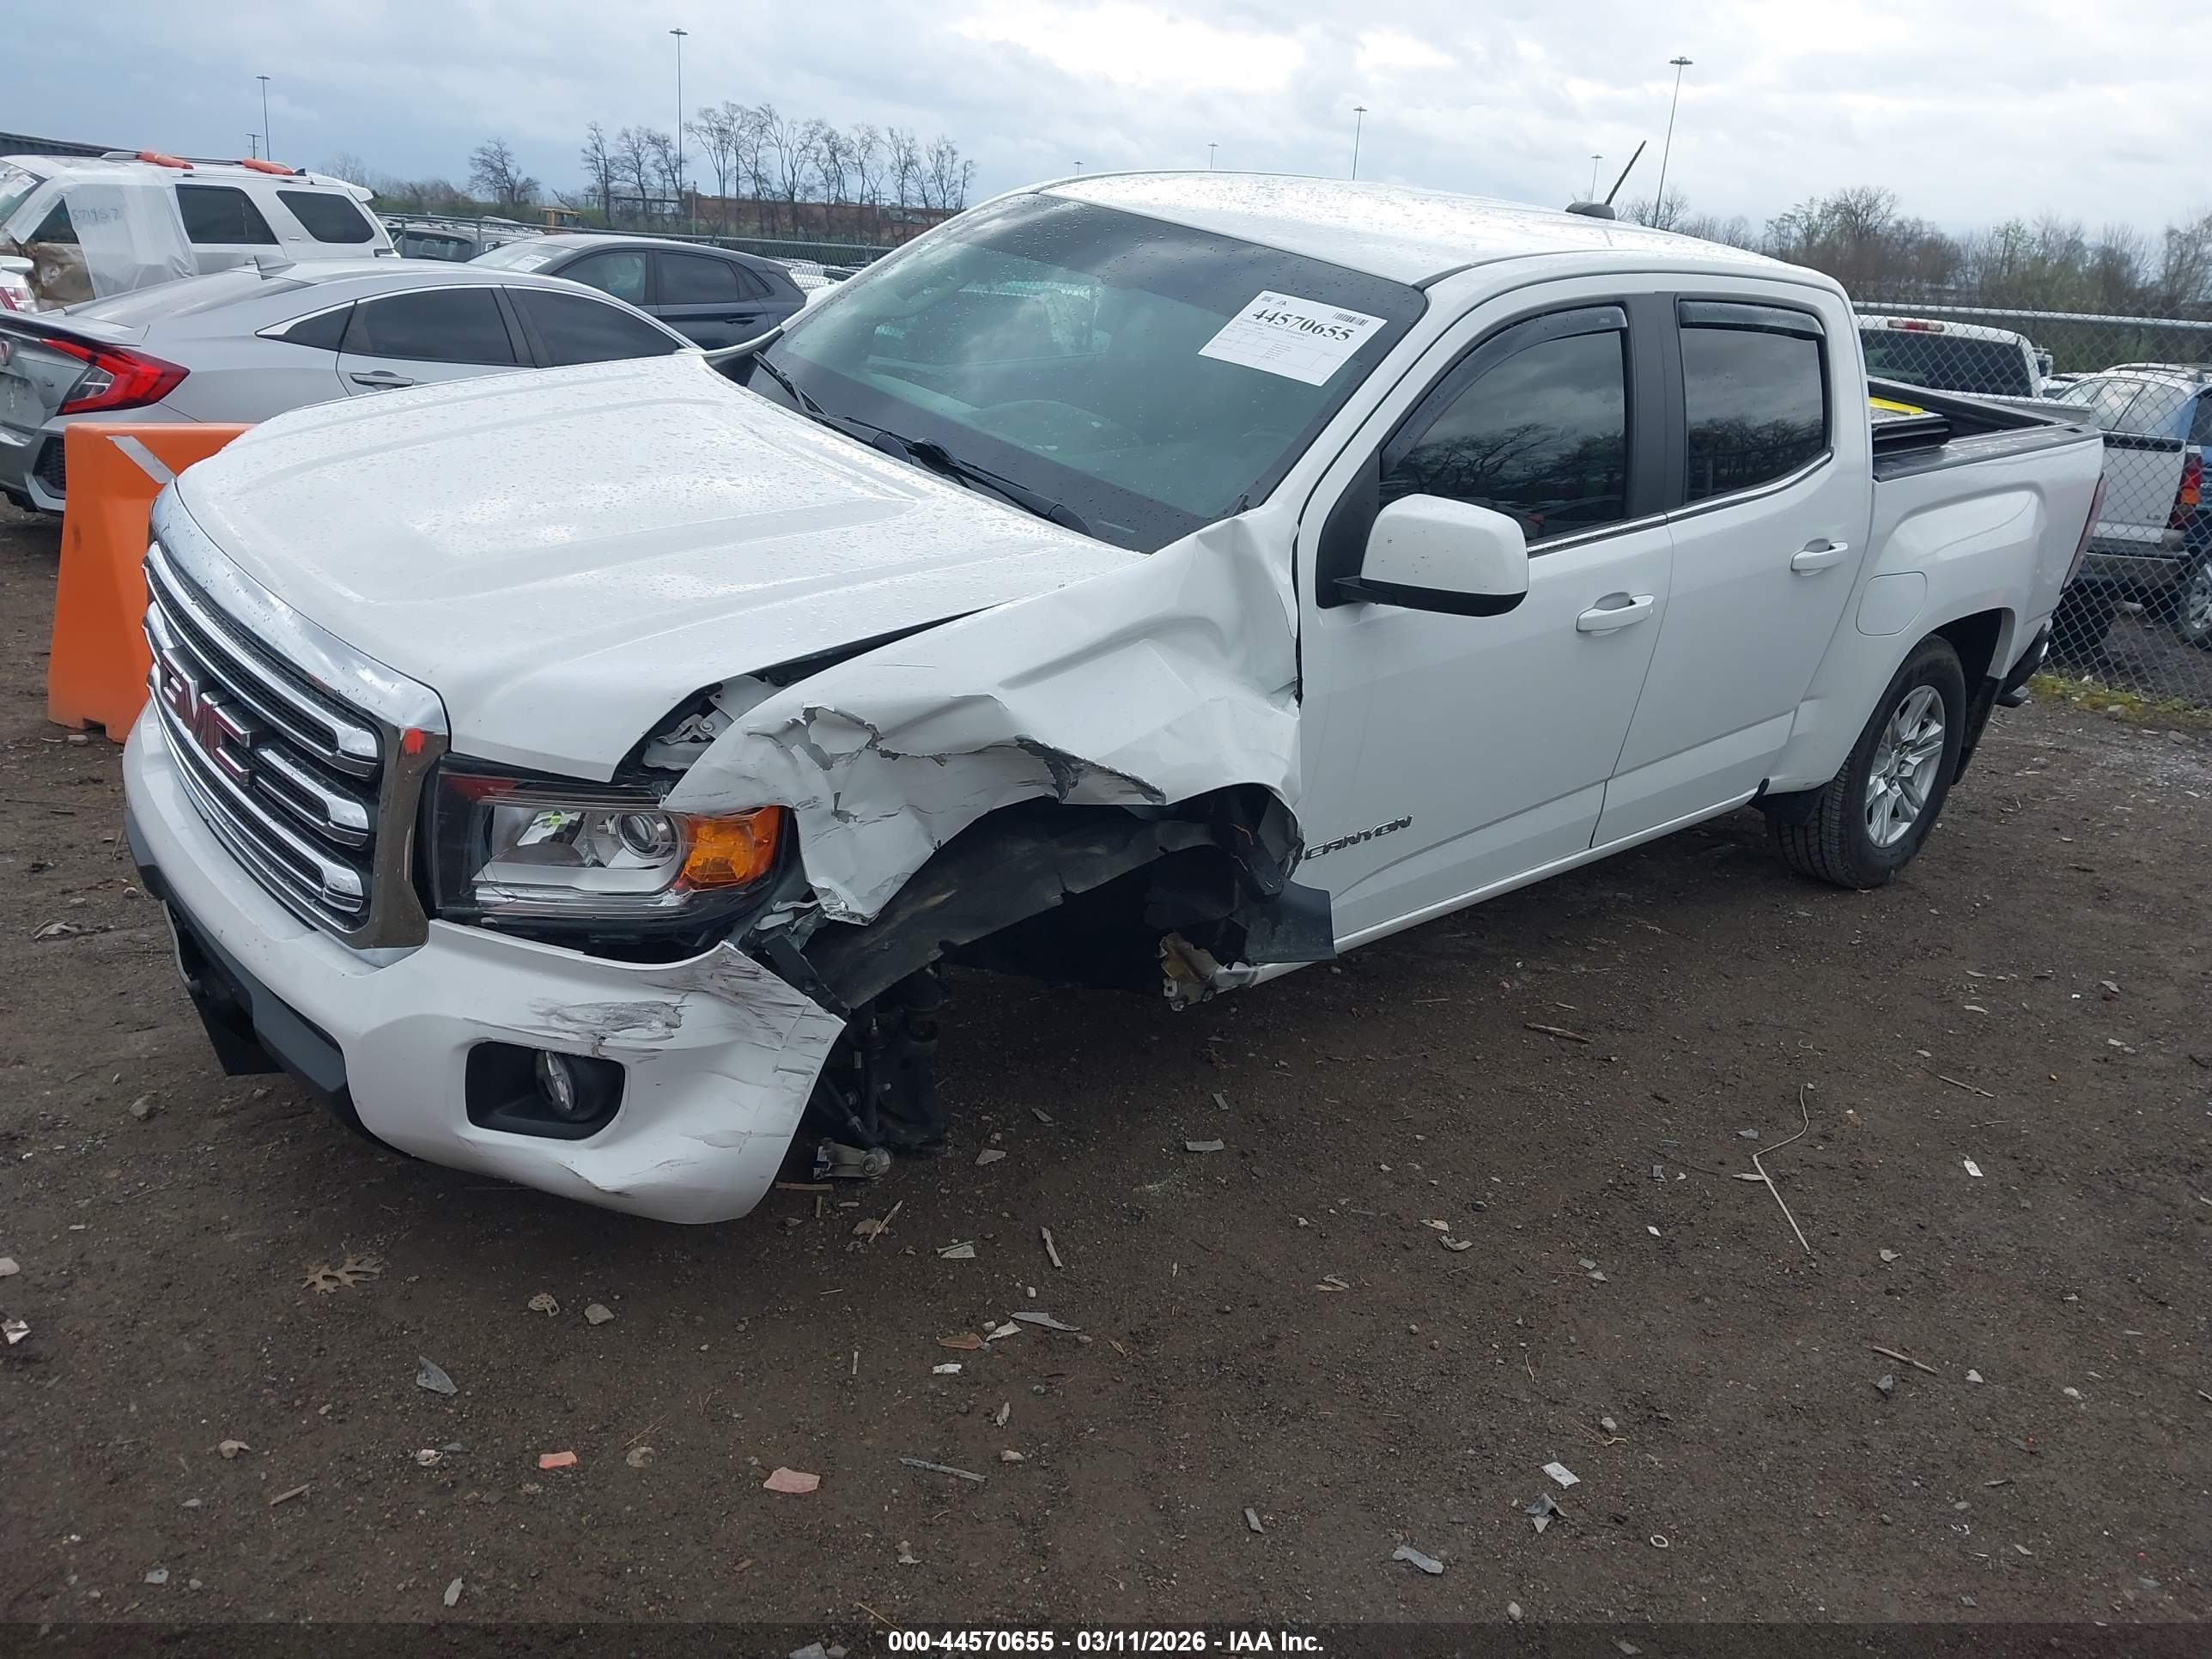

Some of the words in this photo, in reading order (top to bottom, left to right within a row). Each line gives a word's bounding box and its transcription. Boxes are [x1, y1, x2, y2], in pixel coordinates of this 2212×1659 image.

[1252, 308, 1356, 342] 44570655
[159, 645, 252, 787] GMC
[1304, 814, 1414, 860] CANYON
